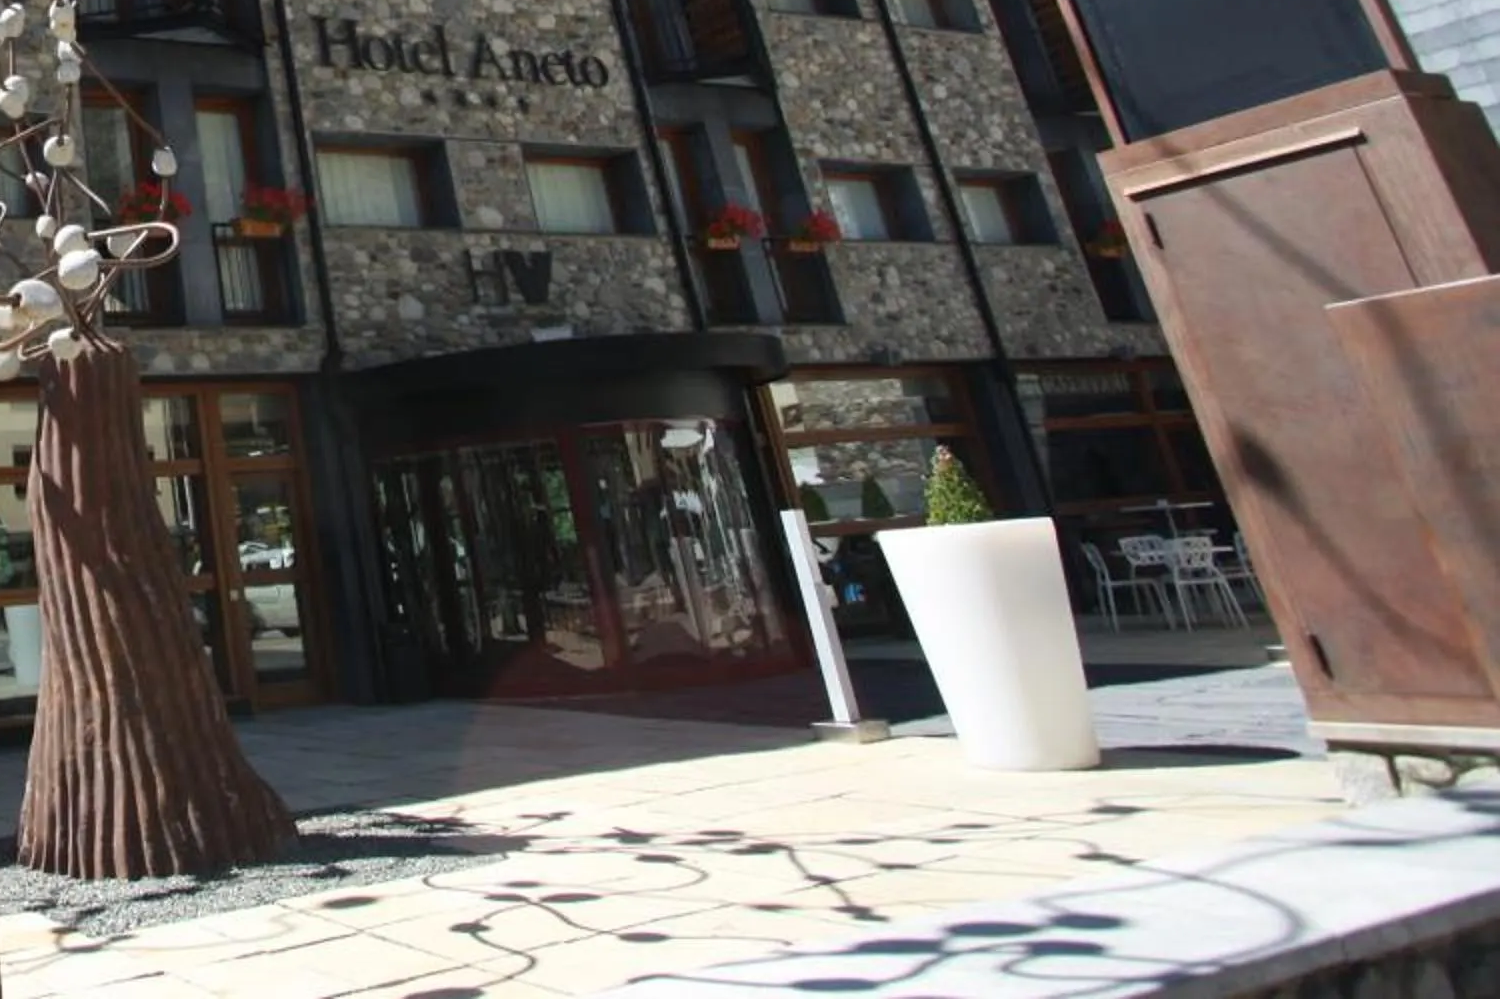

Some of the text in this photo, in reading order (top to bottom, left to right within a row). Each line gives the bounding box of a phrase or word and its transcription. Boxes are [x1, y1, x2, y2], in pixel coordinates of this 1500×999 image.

[310, 14, 610, 89] Hotel Aneto
[465, 249, 553, 304] HV
